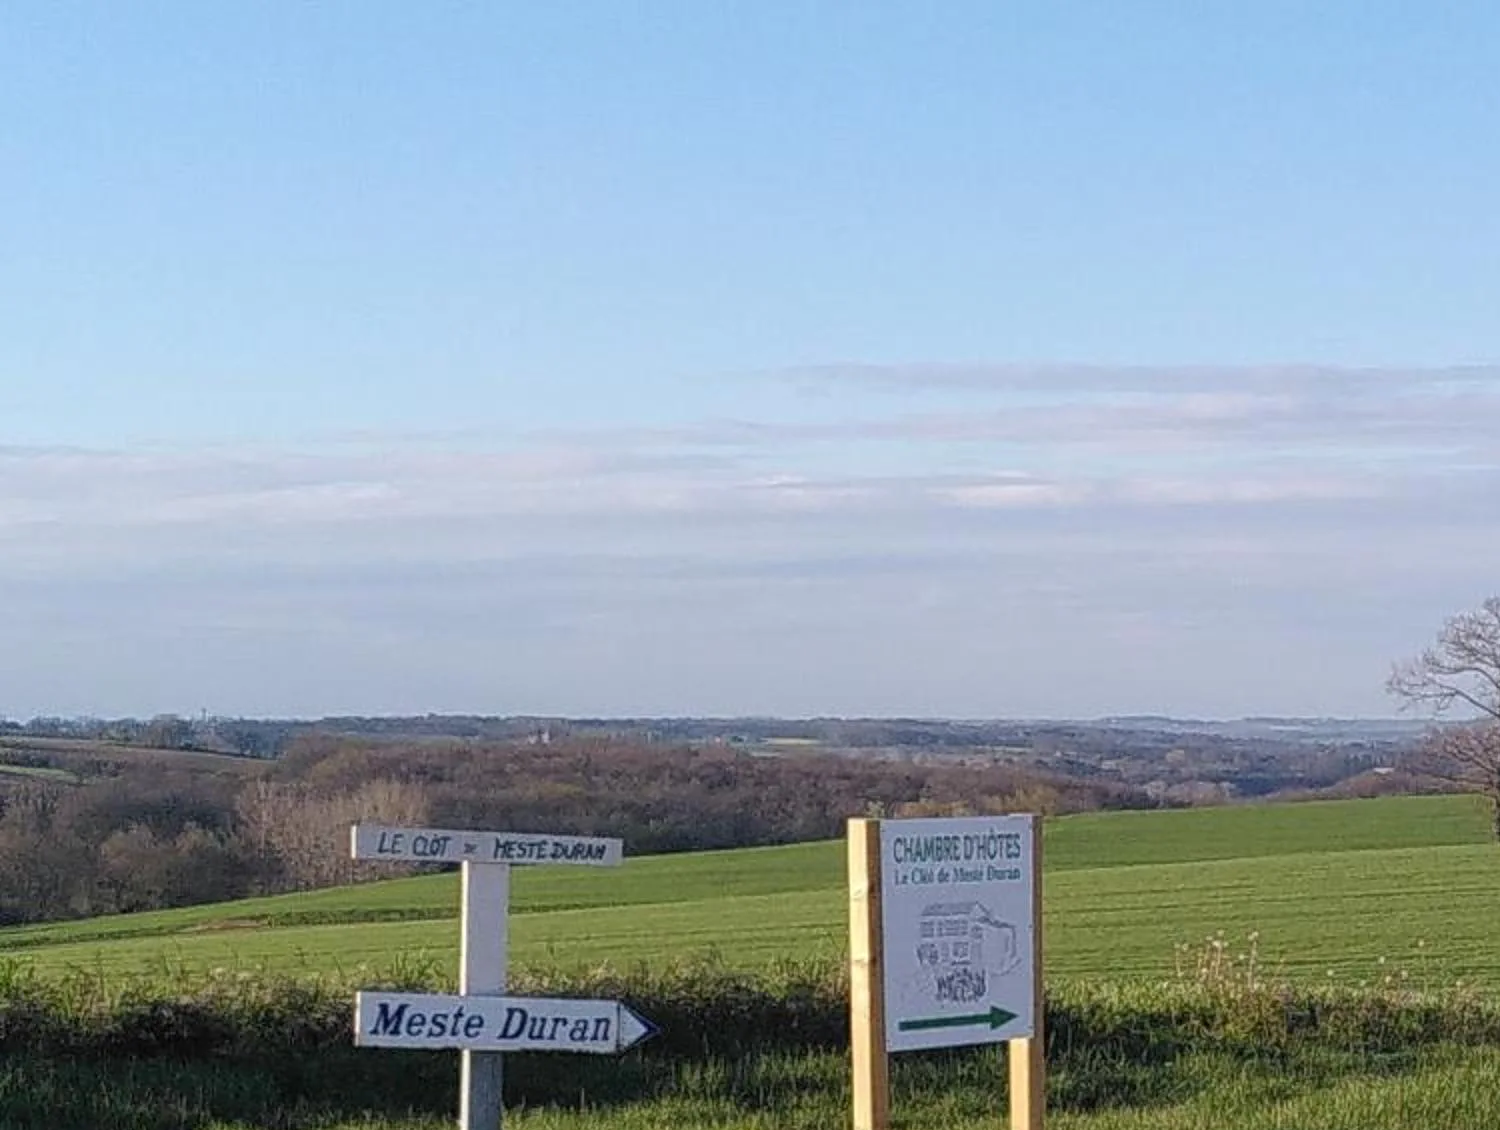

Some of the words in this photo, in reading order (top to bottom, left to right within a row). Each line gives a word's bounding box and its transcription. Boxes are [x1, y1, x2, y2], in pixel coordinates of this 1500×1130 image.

[378, 831, 404, 854] LE
[550, 841, 606, 861] DURAN
[893, 836, 961, 863] CHAMBRE
[963, 828, 1021, 860] D'HÔTES
[894, 870, 908, 885] Le
[937, 868, 950, 883] de
[986, 865, 1021, 881] Duran
[369, 1003, 484, 1038] Meste
[497, 1007, 611, 1042] Duran
